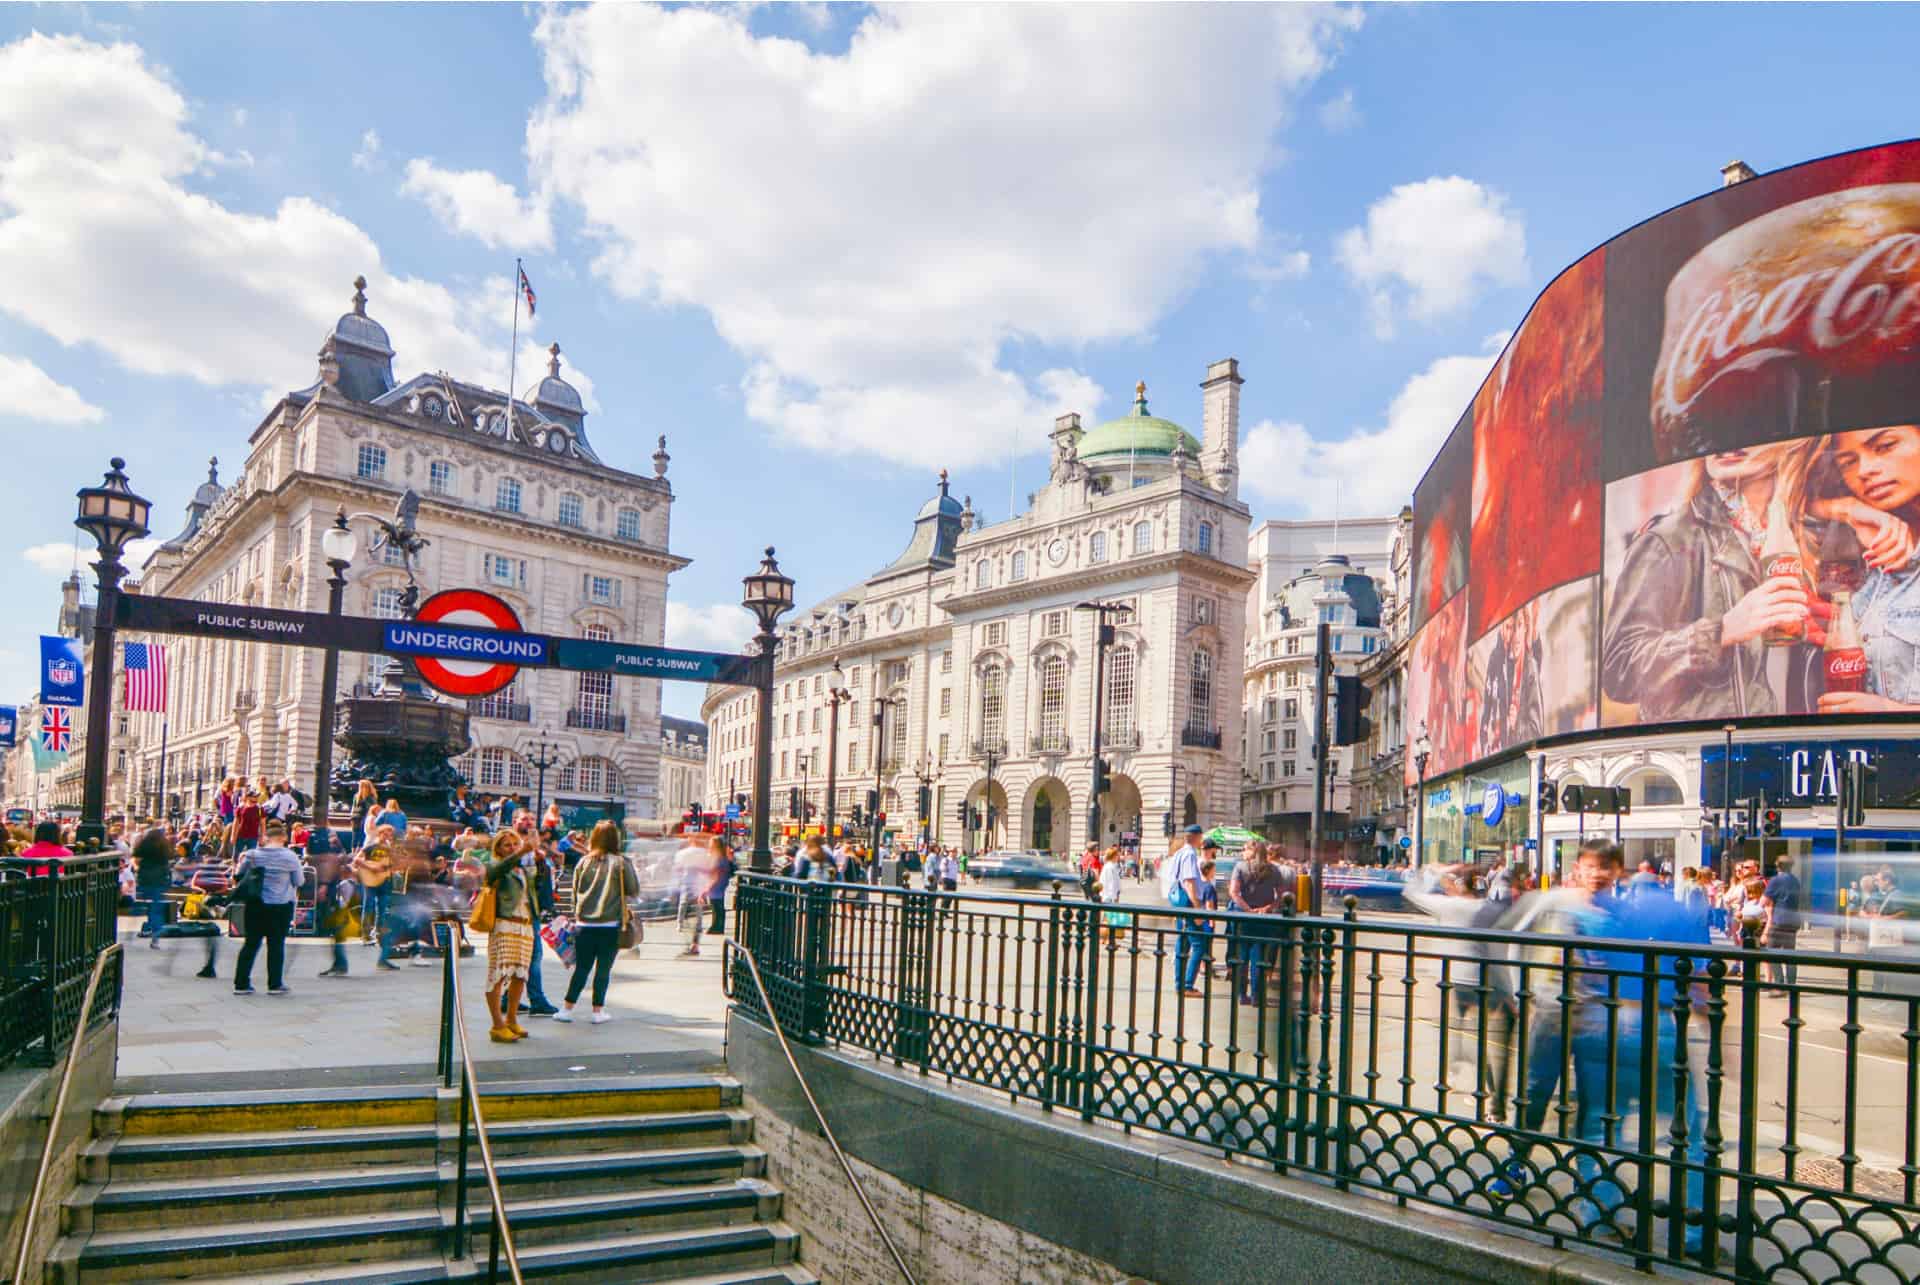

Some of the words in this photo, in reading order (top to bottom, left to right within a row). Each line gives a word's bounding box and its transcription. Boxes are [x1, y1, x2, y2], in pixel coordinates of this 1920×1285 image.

[198, 613, 246, 629] PUBLIC
[249, 619, 305, 634] SUBWAY
[391, 629, 542, 657] UNDERGROUND
[615, 654, 654, 667] PUBLIC
[656, 657, 701, 672] SUBWAY
